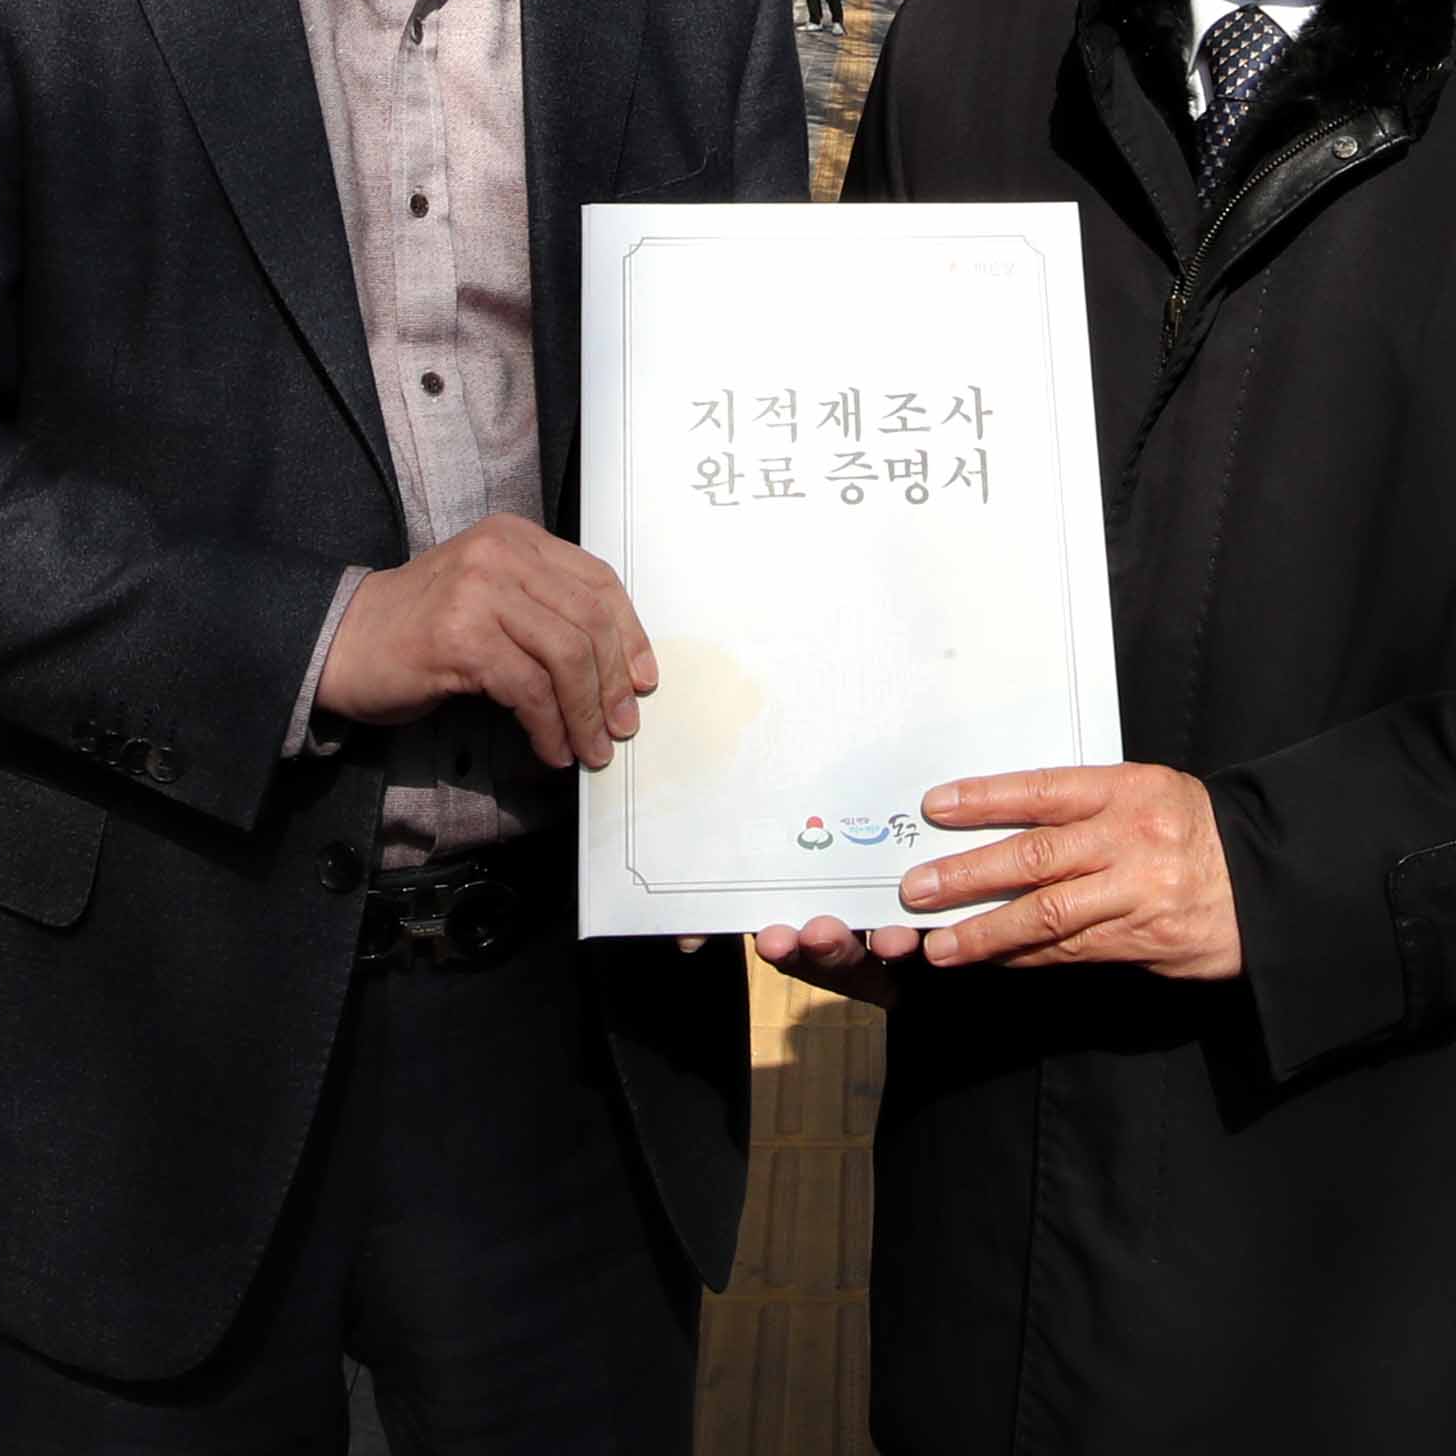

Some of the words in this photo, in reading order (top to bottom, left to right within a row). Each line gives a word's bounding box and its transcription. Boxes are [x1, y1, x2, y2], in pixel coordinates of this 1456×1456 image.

[691, 385, 993, 443] 지적재조사
[691, 452, 806, 506] 완료
[825, 448, 988, 505] 증명서
